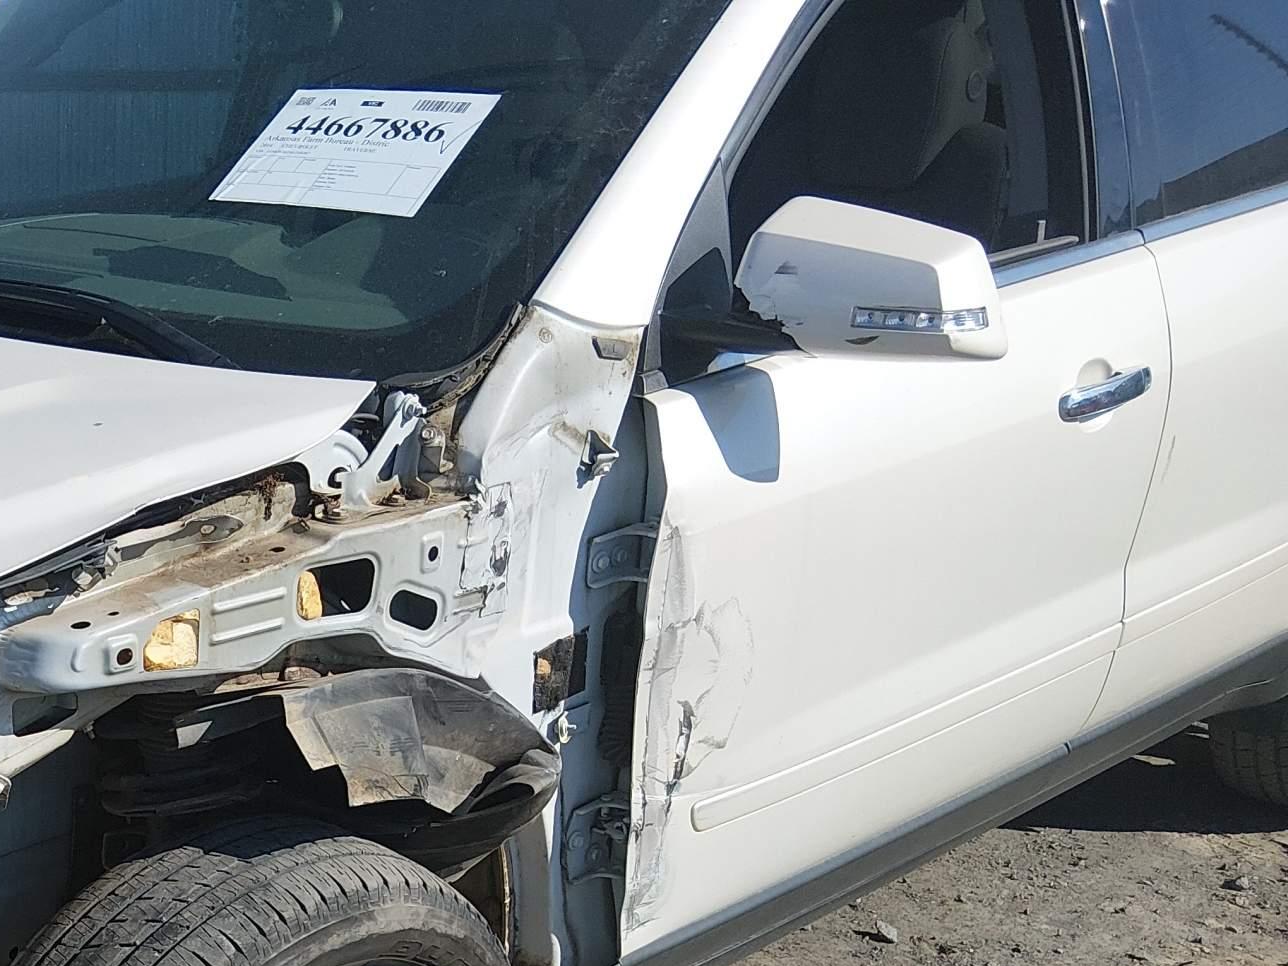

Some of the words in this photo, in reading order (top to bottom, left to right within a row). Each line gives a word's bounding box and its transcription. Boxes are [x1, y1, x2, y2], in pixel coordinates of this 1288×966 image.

[286, 115, 455, 142] 44667886
[266, 135, 301, 143] Arkansas
[302, 136, 324, 144] Farm
